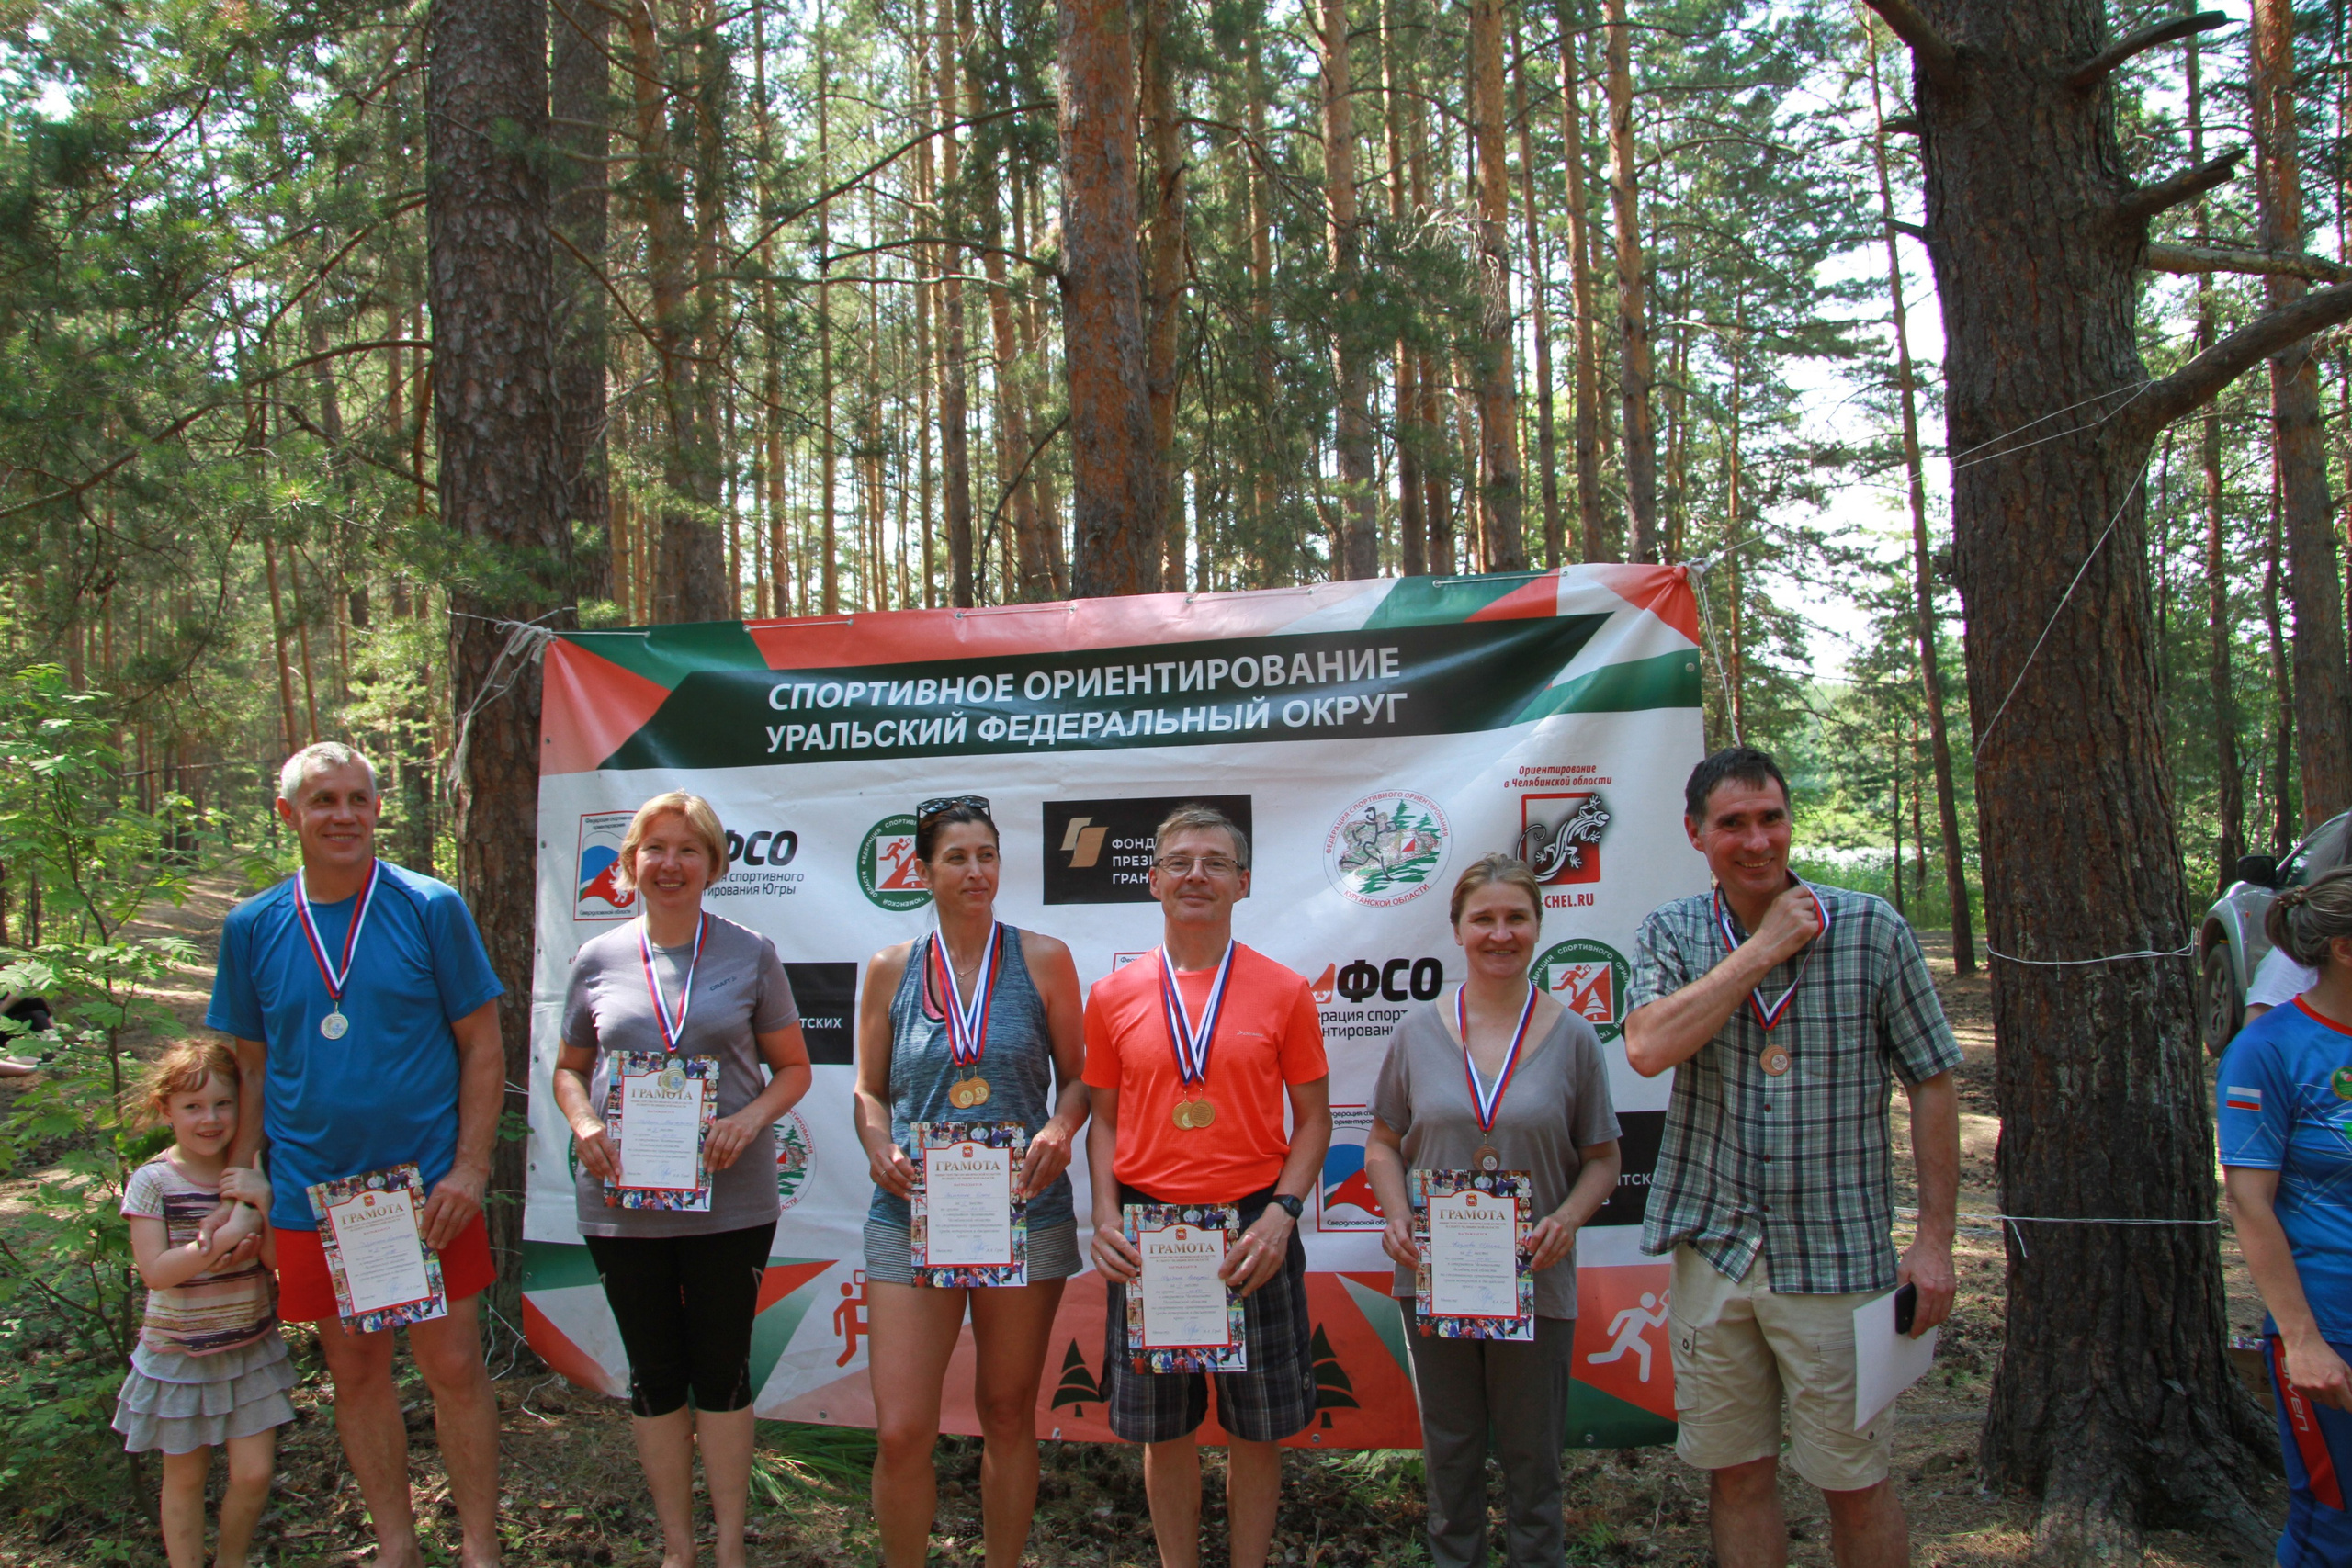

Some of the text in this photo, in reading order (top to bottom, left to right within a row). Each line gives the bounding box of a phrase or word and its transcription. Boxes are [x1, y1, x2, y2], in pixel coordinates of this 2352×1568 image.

[768, 647, 1400, 711] СПОРТИВНОЕ ОРИЕНТИРОВАНИЕ
[765, 693, 1408, 753] УРАЛЬСКИЙ ФЕДЕРАЛЬНЫЙ ОКРУГ
[1519, 765, 1597, 777] Ориентирование
[1512, 776, 1570, 787] Челябинской
[1572, 776, 1612, 786] области
[1326, 791, 1449, 854] ФЕДЕРАЦИЯ СПОРТИВНОГО ОРИЕНТИРОВАНИЯ
[861, 828, 882, 865] ФЕДЕРАЦИЯ
[1112, 838, 1156, 851] ФОНД
[729, 872, 805, 884] спортивного
[862, 871, 878, 897] ОБЛАСТИ
[1113, 873, 1149, 884] ГРАН
[702, 883, 797, 898] тирования Югры
[1343, 884, 1430, 907] КУРГАНСКОЙ ОБЛАСТИ
[883, 896, 925, 907] ТЮМЕНСКОЙ
[1532, 954, 1555, 987] ДЕРАЦИЯ
[1557, 943, 1613, 960] СПОРТИВНОГО
[1337, 957, 1443, 1003] ФСО
[799, 1017, 842, 1029] ТСКИХ
[1318, 1010, 1363, 1025] рация
[1321, 1025, 1393, 1040] нтирован
[631, 1088, 693, 1100] ГРАМОТА
[788, 1107, 814, 1154] НТИРОВАНИЯ
[935, 1160, 1001, 1171] ГРАМОТА
[781, 1197, 798, 1211] АСТИ
[341, 1203, 404, 1225] ГРАМОТА
[1440, 1209, 1505, 1220] ГРАМОТА
[1149, 1242, 1216, 1255] ГРАМОТА
